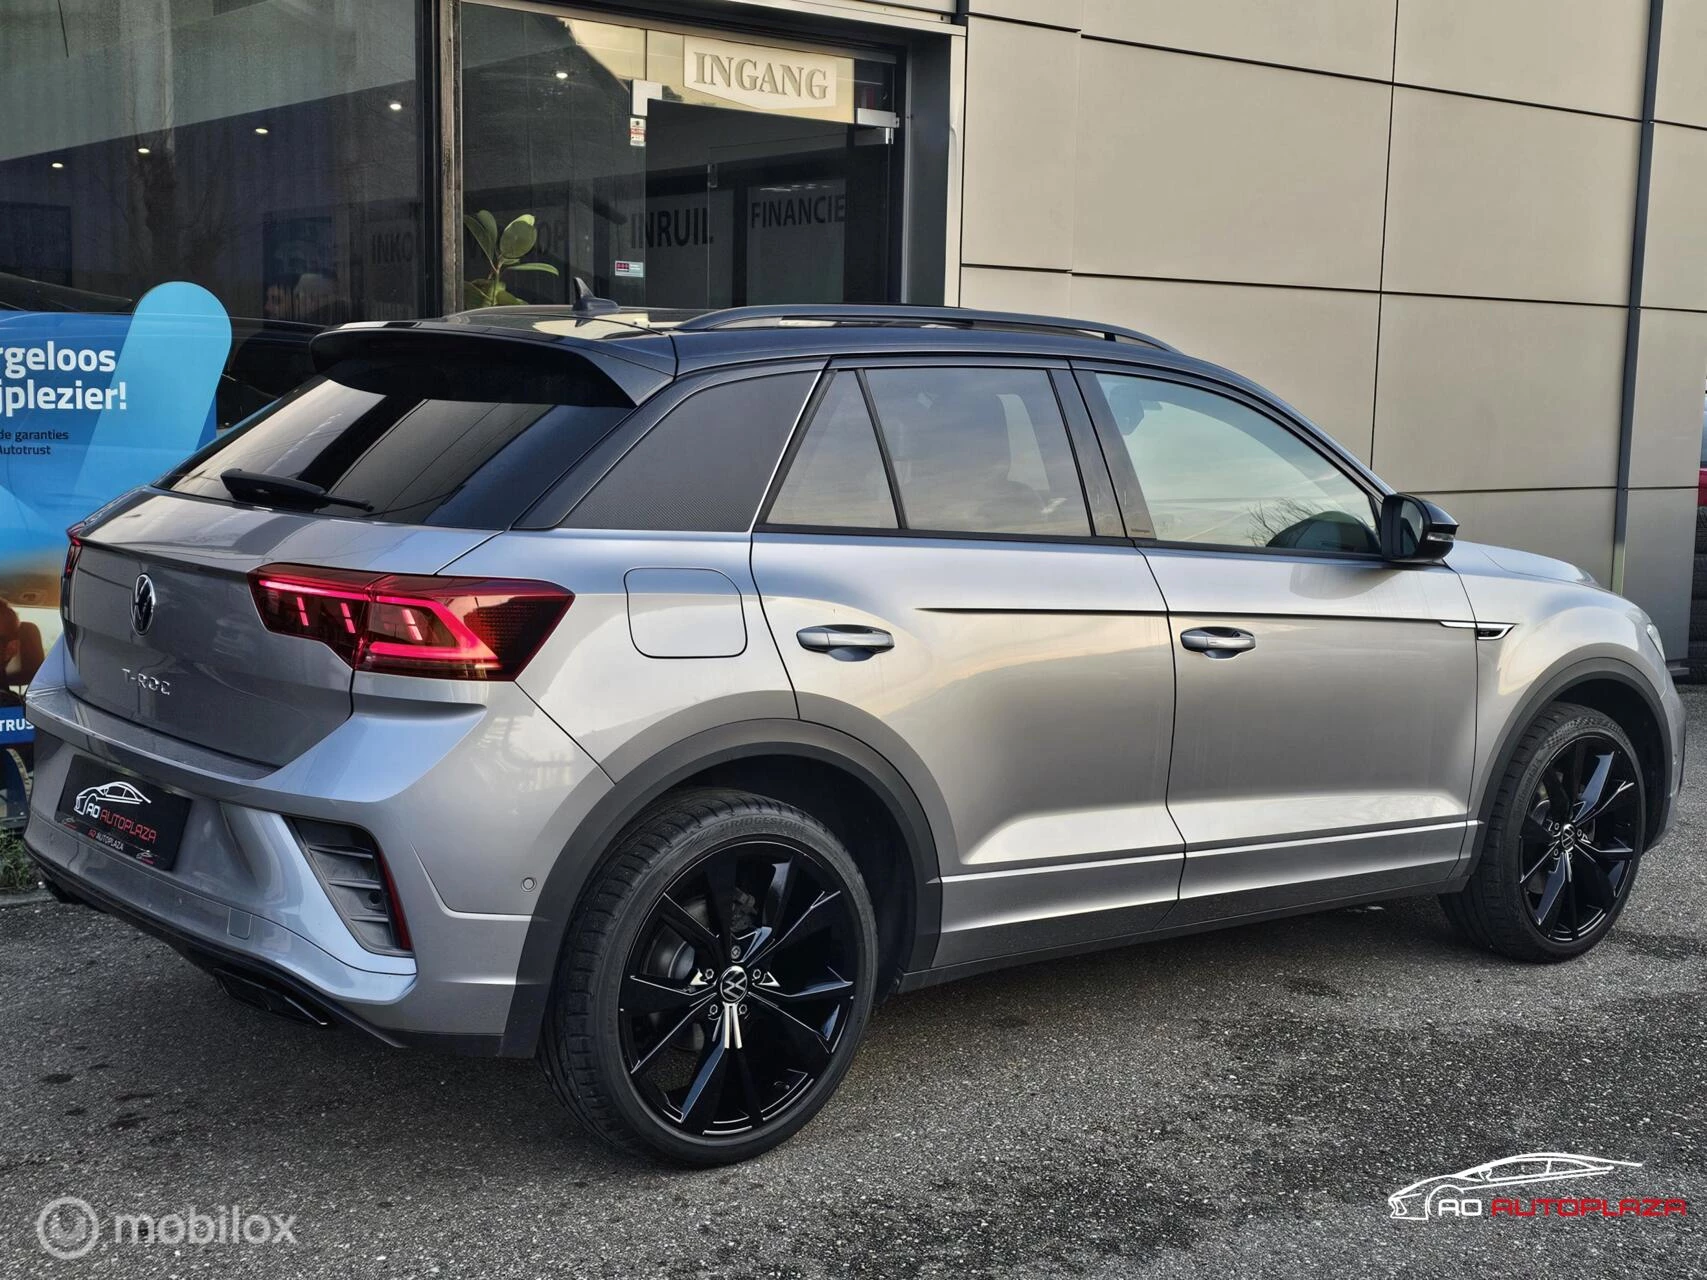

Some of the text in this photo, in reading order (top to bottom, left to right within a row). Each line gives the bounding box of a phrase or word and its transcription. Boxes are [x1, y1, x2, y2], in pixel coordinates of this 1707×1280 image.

[693, 51, 828, 100] INGANG
[15, 429, 69, 442] garanties
[121, 668, 171, 695] T-ROC
[101, 810, 157, 843] AUTOPLAZA
